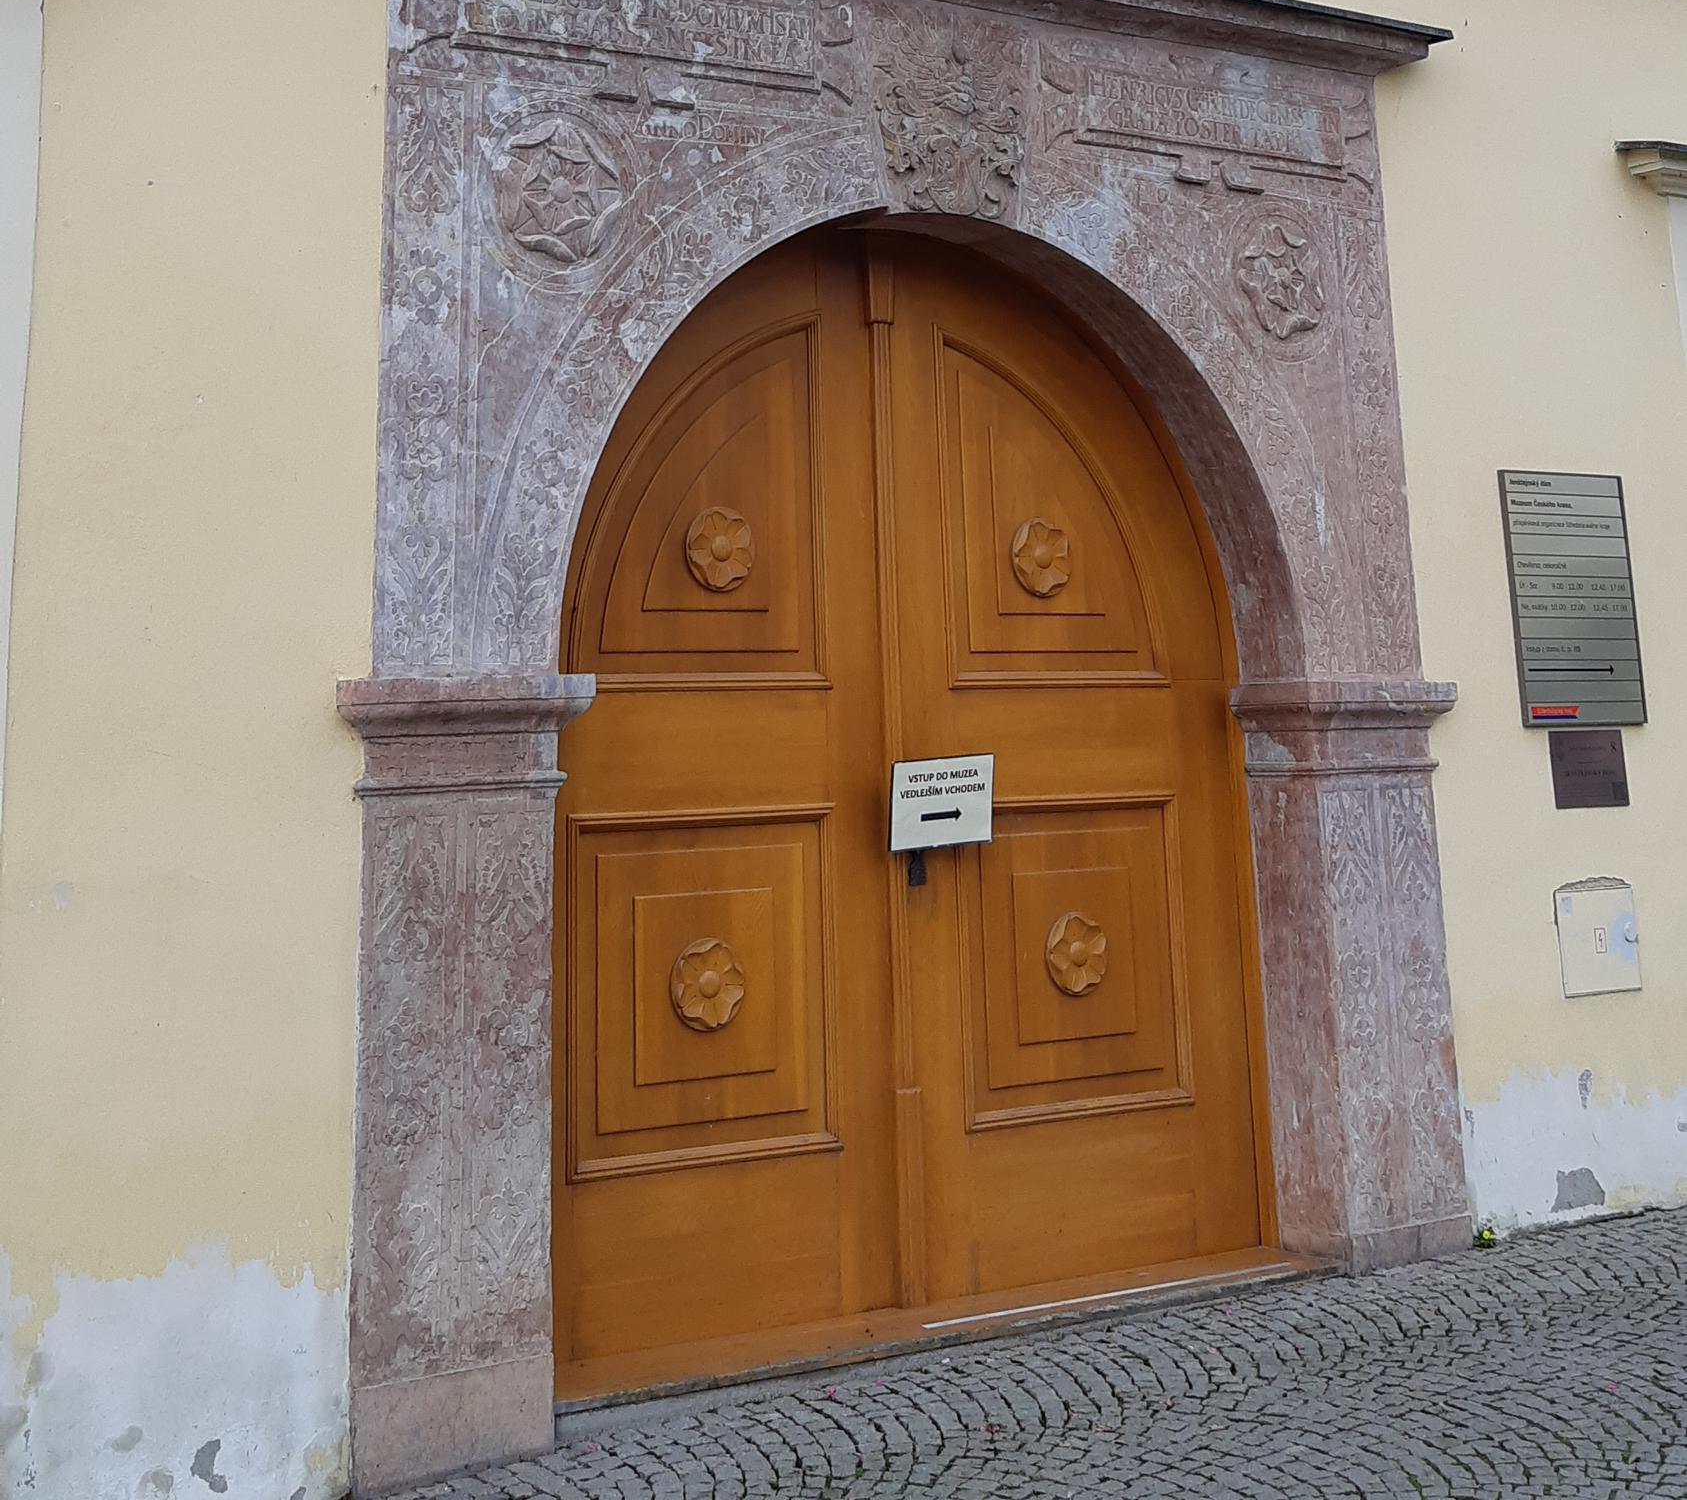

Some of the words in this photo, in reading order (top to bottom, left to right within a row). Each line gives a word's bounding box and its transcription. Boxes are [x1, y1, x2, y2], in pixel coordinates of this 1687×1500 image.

[908, 773, 934, 783] VSTUP
[936, 772, 949, 781] DO
[950, 769, 979, 779] MUZEA
[900, 785, 943, 799] VEDLEJŠÍM
[945, 783, 986, 795] VCHODEM
